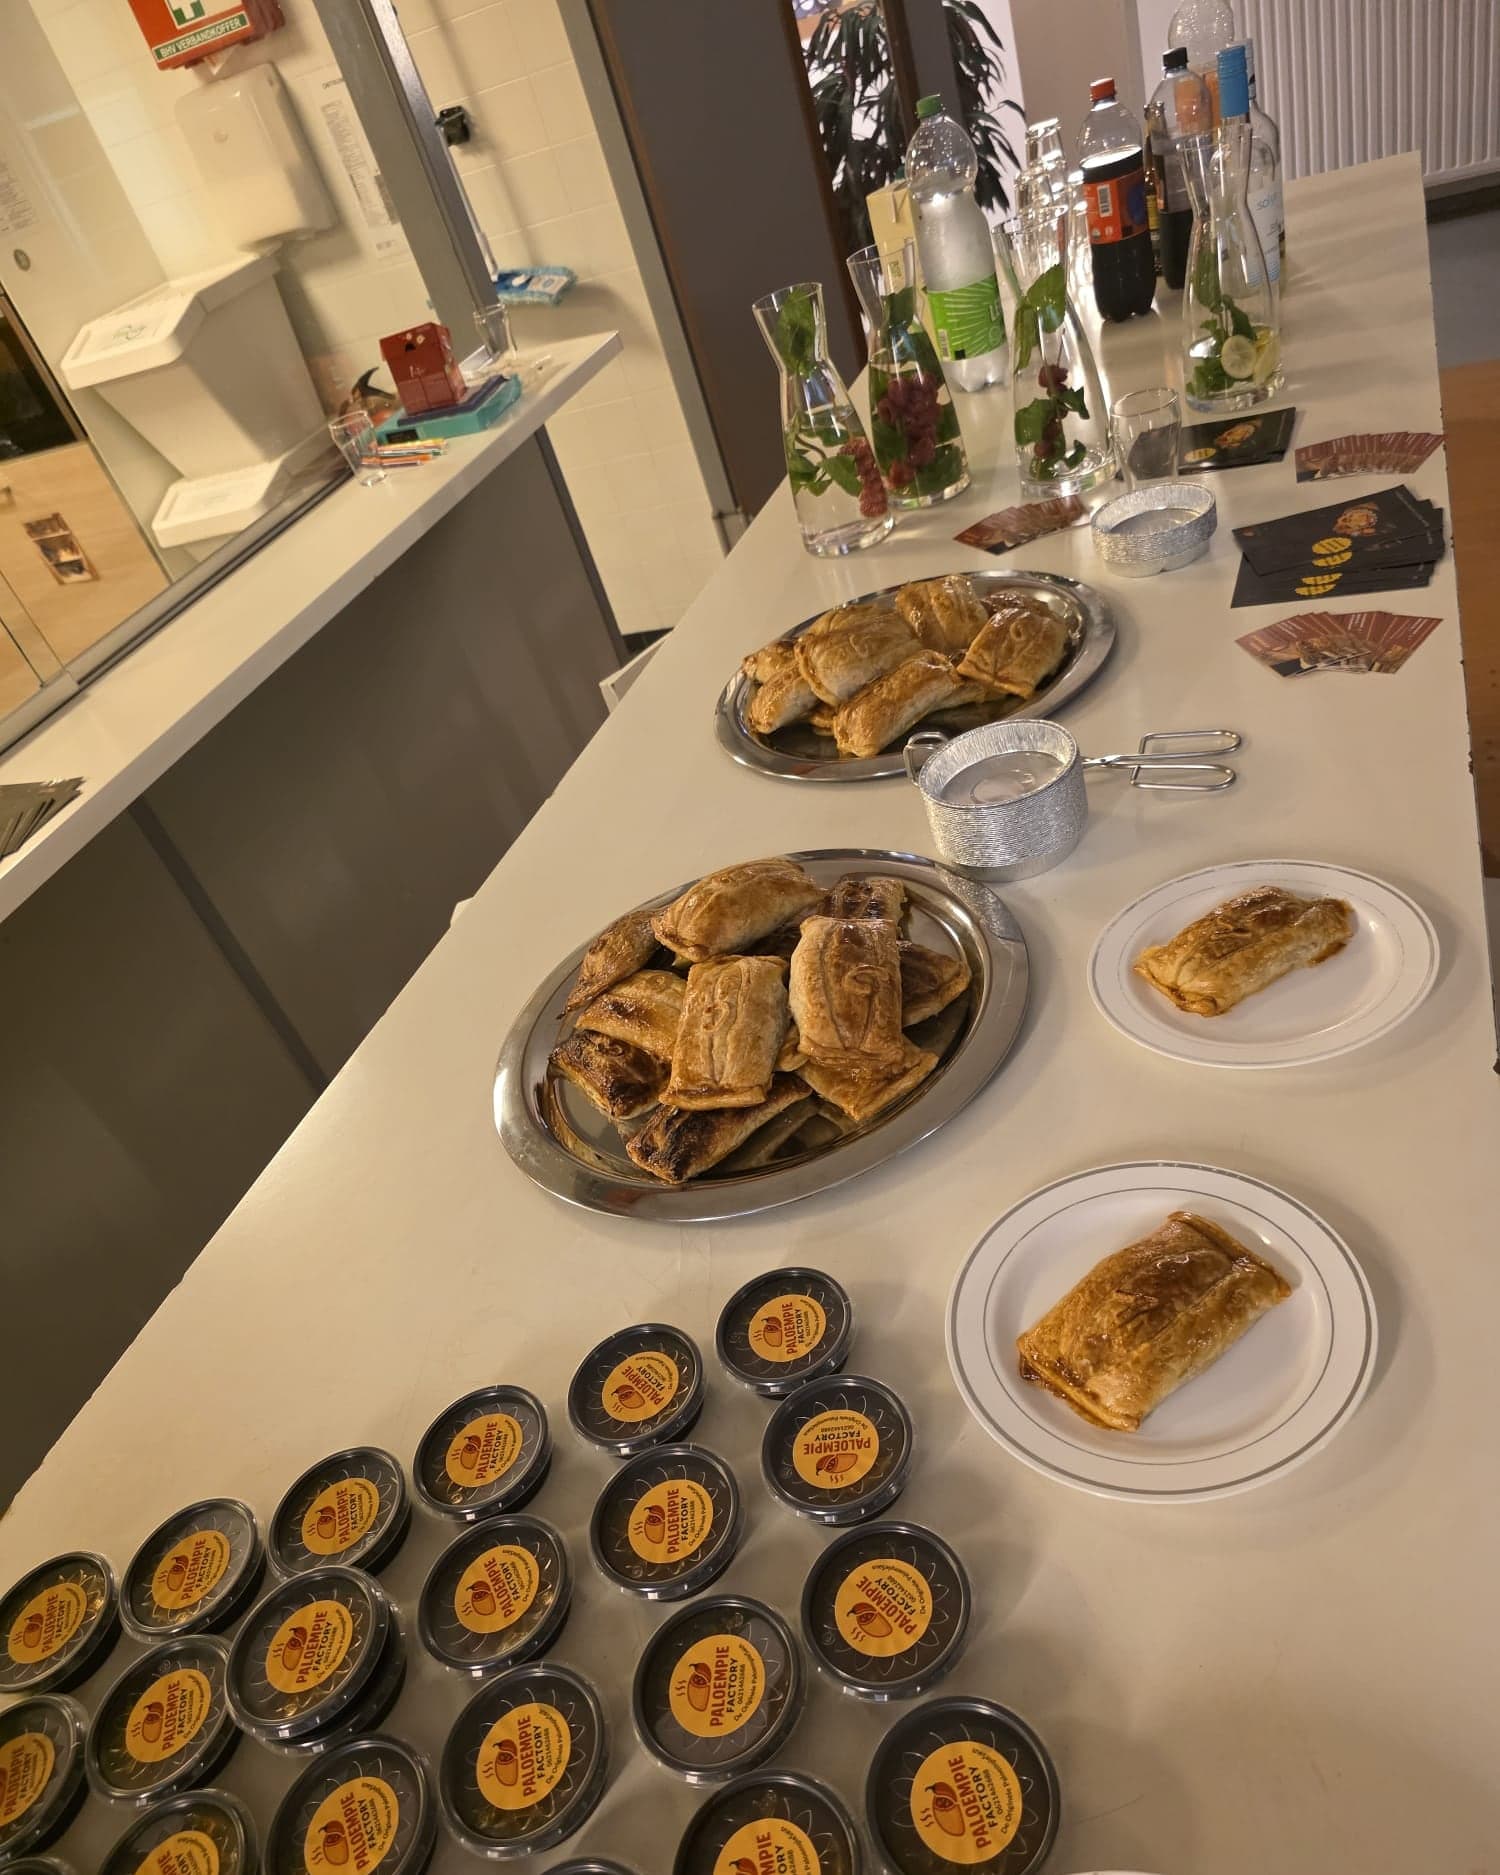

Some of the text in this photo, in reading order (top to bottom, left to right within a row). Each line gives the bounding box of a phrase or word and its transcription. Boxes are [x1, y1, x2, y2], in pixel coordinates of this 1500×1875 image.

[160, 18, 241, 58] BHV VERBANDKOFFER
[781, 1301, 798, 1355] PALOEMPIE
[793, 1308, 805, 1344] FACTORY
[620, 1364, 665, 1406] PALOEMPIE
[635, 1365, 665, 1392] FACTORY
[474, 1420, 498, 1480] PALOEMPIE
[488, 1429, 503, 1469] FACTORY
[803, 1436, 871, 1455] PALOEMPIE
[813, 1429, 860, 1442] FACTORY
[335, 1486, 351, 1545] PALOEMPIE
[348, 1493, 358, 1531] FACTORY
[666, 1487, 680, 1554] PALOEMPIE
[679, 1496, 688, 1541] FACTORY
[179, 1538, 207, 1601] PALOEMPIE
[194, 1546, 211, 1588] FACTORY
[482, 1556, 516, 1619] PALOEMPIE
[498, 1561, 521, 1602] FACTORY
[854, 1574, 918, 1636] PALOEMPIE
[873, 1577, 916, 1616] FACTORY
[294, 1610, 328, 1684] PALOEMPIE
[311, 1620, 332, 1671] FACTORY
[176, 1688, 188, 1735] FACTORY
[708, 1645, 730, 1727] PALOEMPIE
[725, 1657, 738, 1713] FACTORY
[161, 1678, 180, 1752] PALOEMPIE
[516, 1714, 537, 1798] PALOEMPIE
[532, 1725, 545, 1779] FACTORY
[356, 1798, 377, 1850] FACTORY
[946, 1753, 992, 1849] PALOEMPIE
[967, 1766, 998, 1828] FACTORY
[339, 1790, 370, 1871] PALOEMPIE
